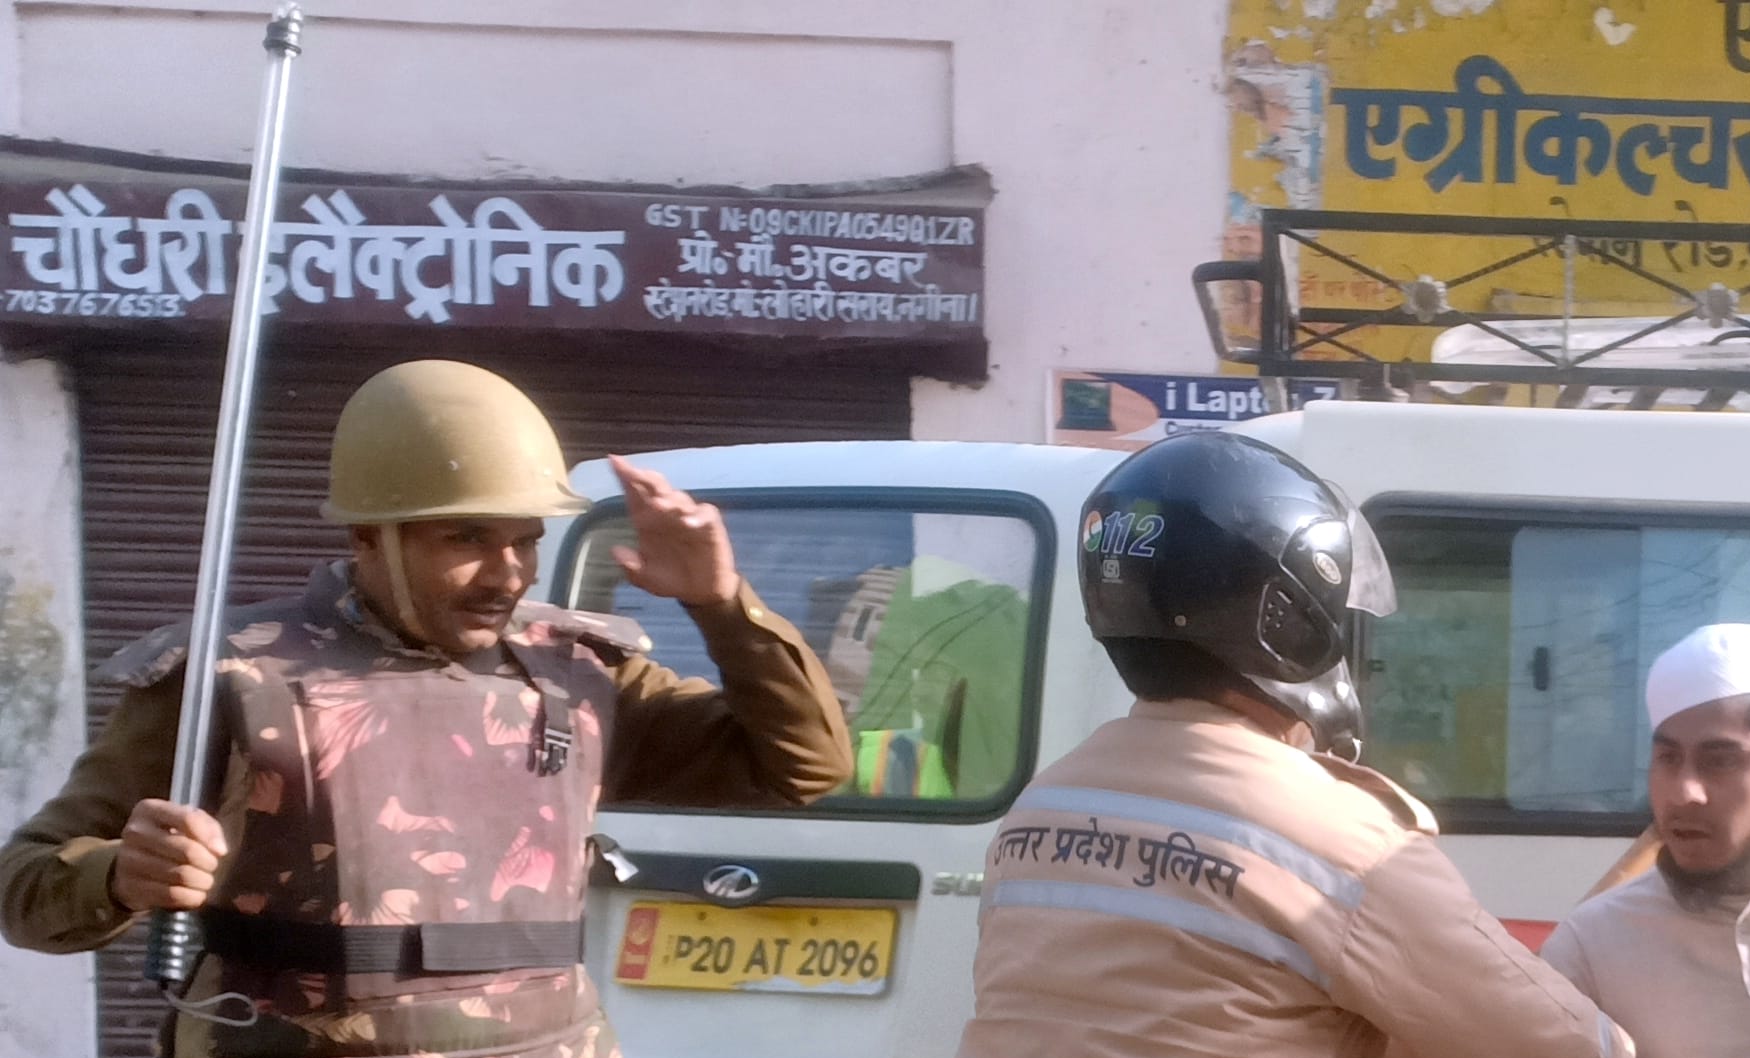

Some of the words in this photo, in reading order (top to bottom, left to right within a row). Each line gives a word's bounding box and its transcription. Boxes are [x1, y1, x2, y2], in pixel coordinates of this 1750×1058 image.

[645, 204, 710, 229] GST
[1166, 381, 1177, 411] i
[1101, 511, 1165, 558] 112
[1051, 817, 1130, 870] प्रदेश
[1133, 831, 1245, 898] पुलिस
[743, 938, 791, 975] AT
[796, 939, 879, 977] 2096
